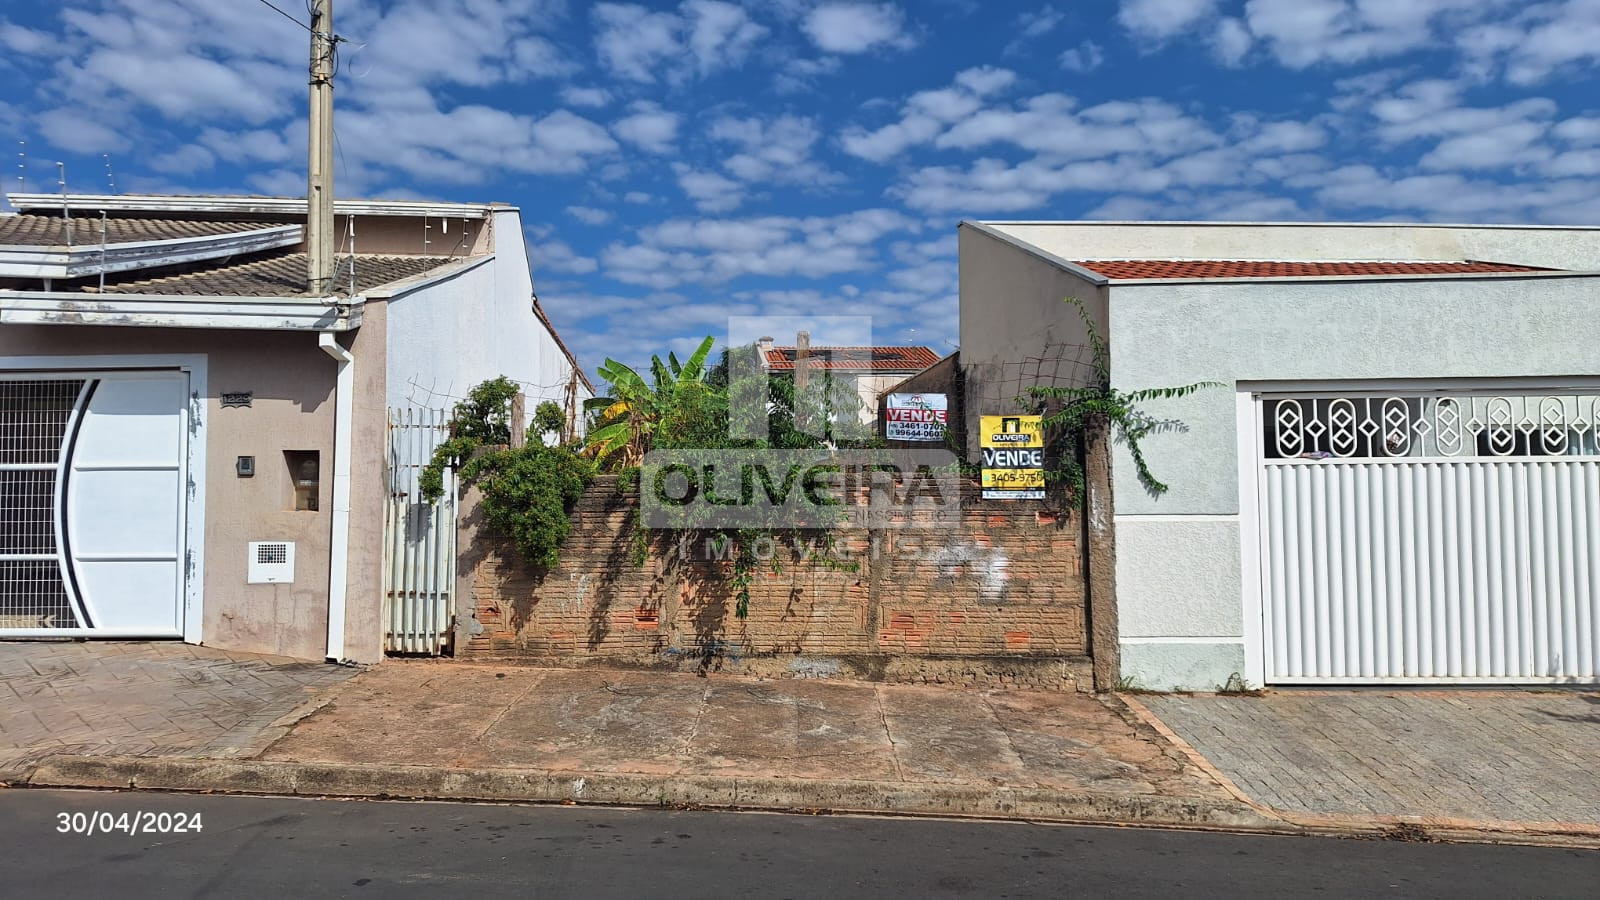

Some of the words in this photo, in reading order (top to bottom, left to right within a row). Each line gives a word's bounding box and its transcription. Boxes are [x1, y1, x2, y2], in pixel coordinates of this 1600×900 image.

[888, 409, 946, 422] VENDE
[983, 449, 1042, 467] VENDE
[991, 473, 1043, 482] 3405-9750
